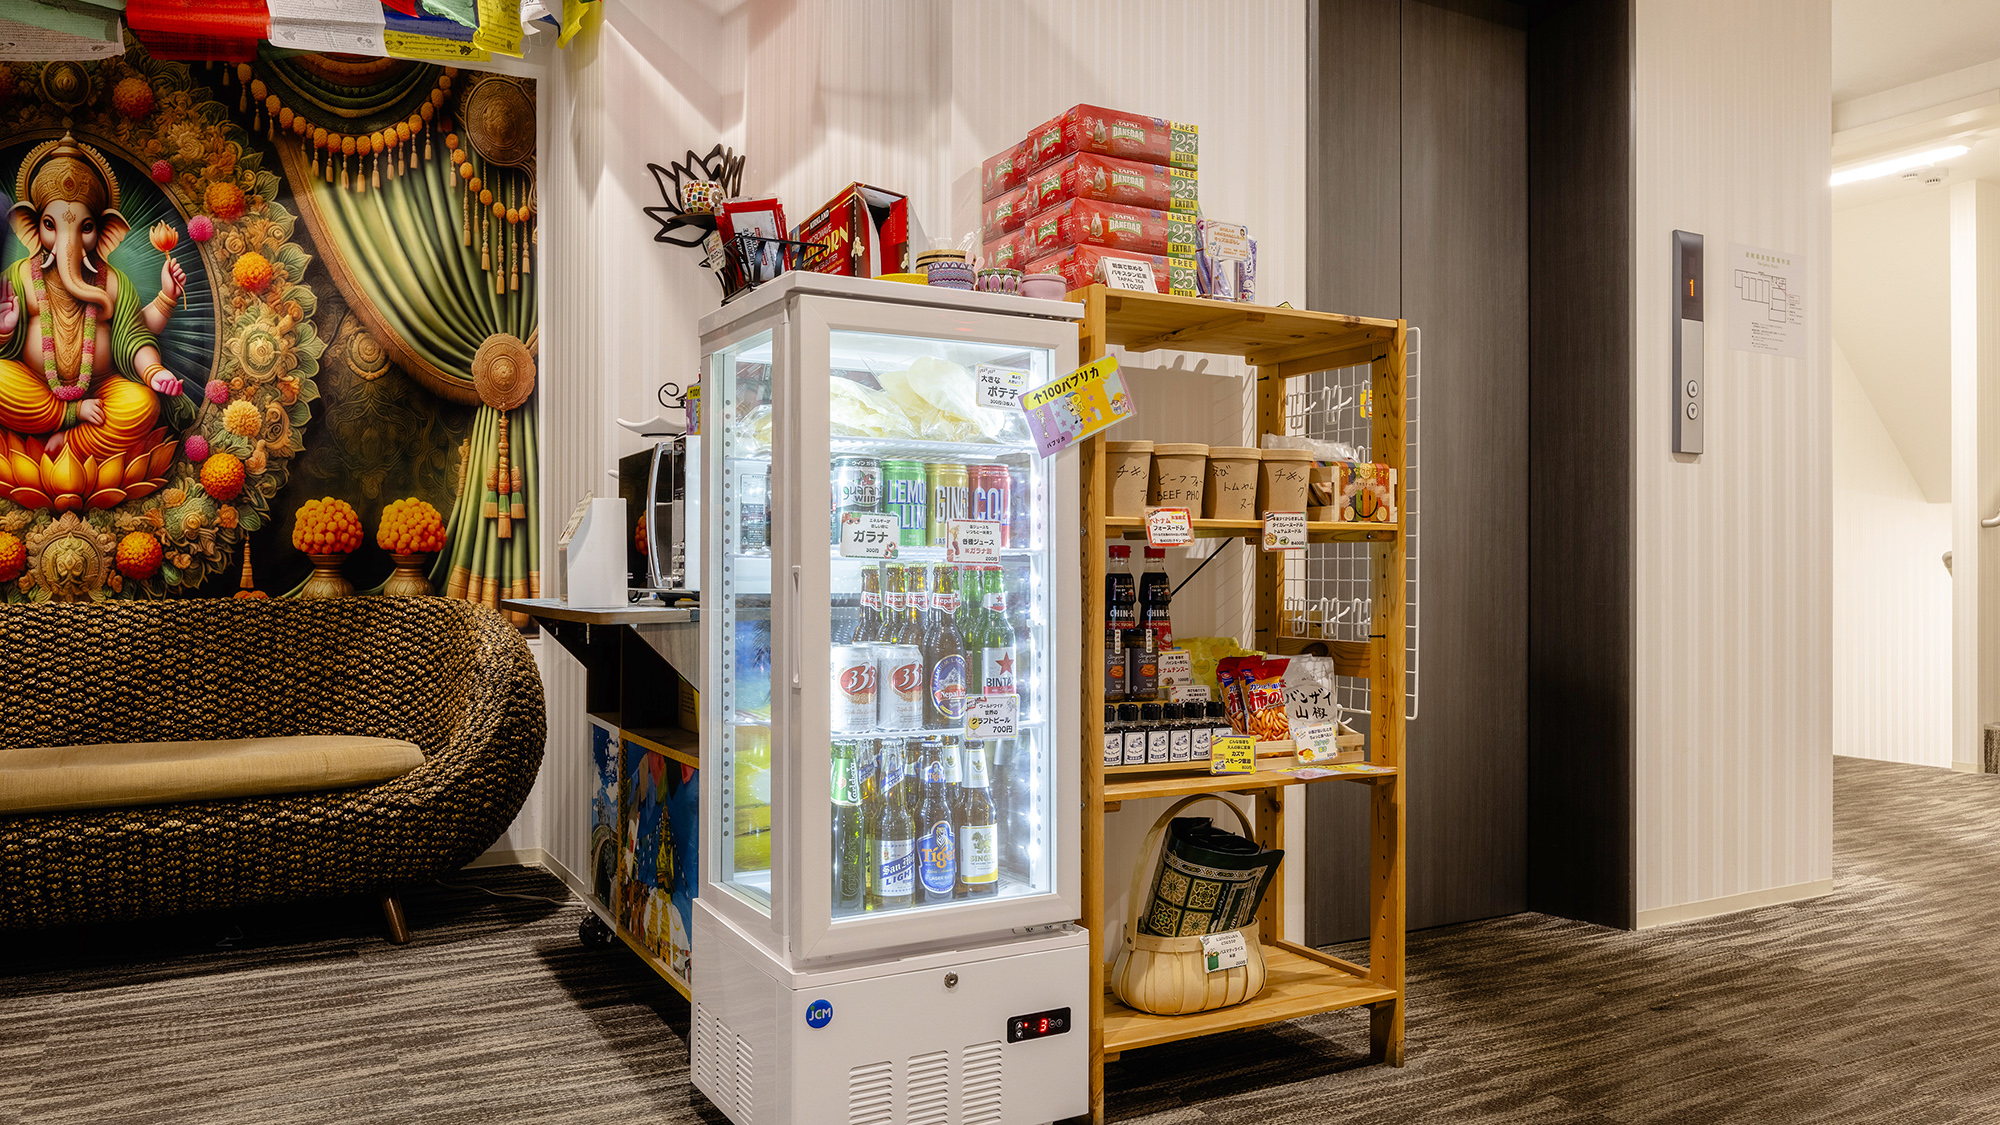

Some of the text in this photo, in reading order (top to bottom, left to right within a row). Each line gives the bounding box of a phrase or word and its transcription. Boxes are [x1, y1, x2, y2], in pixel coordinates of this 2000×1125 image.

[1118, 121, 1138, 129] TAPAL
[1174, 122, 1195, 132] FREE
[1113, 127, 1144, 143] DANEDAR
[1174, 133, 1196, 153] 25
[1175, 153, 1195, 162] EXTRA
[1173, 170, 1195, 179] FREE
[1113, 174, 1144, 190] DANEDAR
[1174, 180, 1196, 200] 25
[1175, 200, 1195, 209] EXTRA
[1171, 213, 1192, 222] FREE
[1110, 219, 1141, 235] DANEDAR
[1172, 224, 1194, 243] 25
[1172, 244, 1192, 253] EXTRA
[1173, 259, 1193, 268] FREE
[1174, 269, 1195, 289] 25
[1689, 278, 1694, 297] 1
[981, 374, 1001, 385] 大きな
[987, 386, 1018, 400] ポテチ
[1046, 436, 1066, 449] パプリカ
[1274, 467, 1305, 483] チキン
[887, 480, 926, 505] LEMO
[1156, 489, 1200, 502] BEEF PHO
[935, 485, 969, 524] GING
[972, 487, 1010, 526] COL
[900, 504, 926, 530] LIM
[853, 530, 889, 544] ガラナ
[962, 538, 995, 546] 各種ジュース
[1109, 609, 1134, 618] CHIN-S
[1146, 609, 1170, 618] CHIN-S
[844, 661, 875, 693] 333
[986, 677, 1012, 687] BINTA
[940, 690, 959, 699] Nepal
[1248, 689, 1284, 713] 柿の
[1286, 687, 1332, 706] バンザイ
[971, 717, 1011, 725] クラフトビール
[992, 725, 1013, 734] 700円
[847, 762, 858, 802] Carlsberg
[921, 847, 956, 869] Tiger
[882, 865, 899, 876] San
[1039, 1018, 1048, 1032] 3
